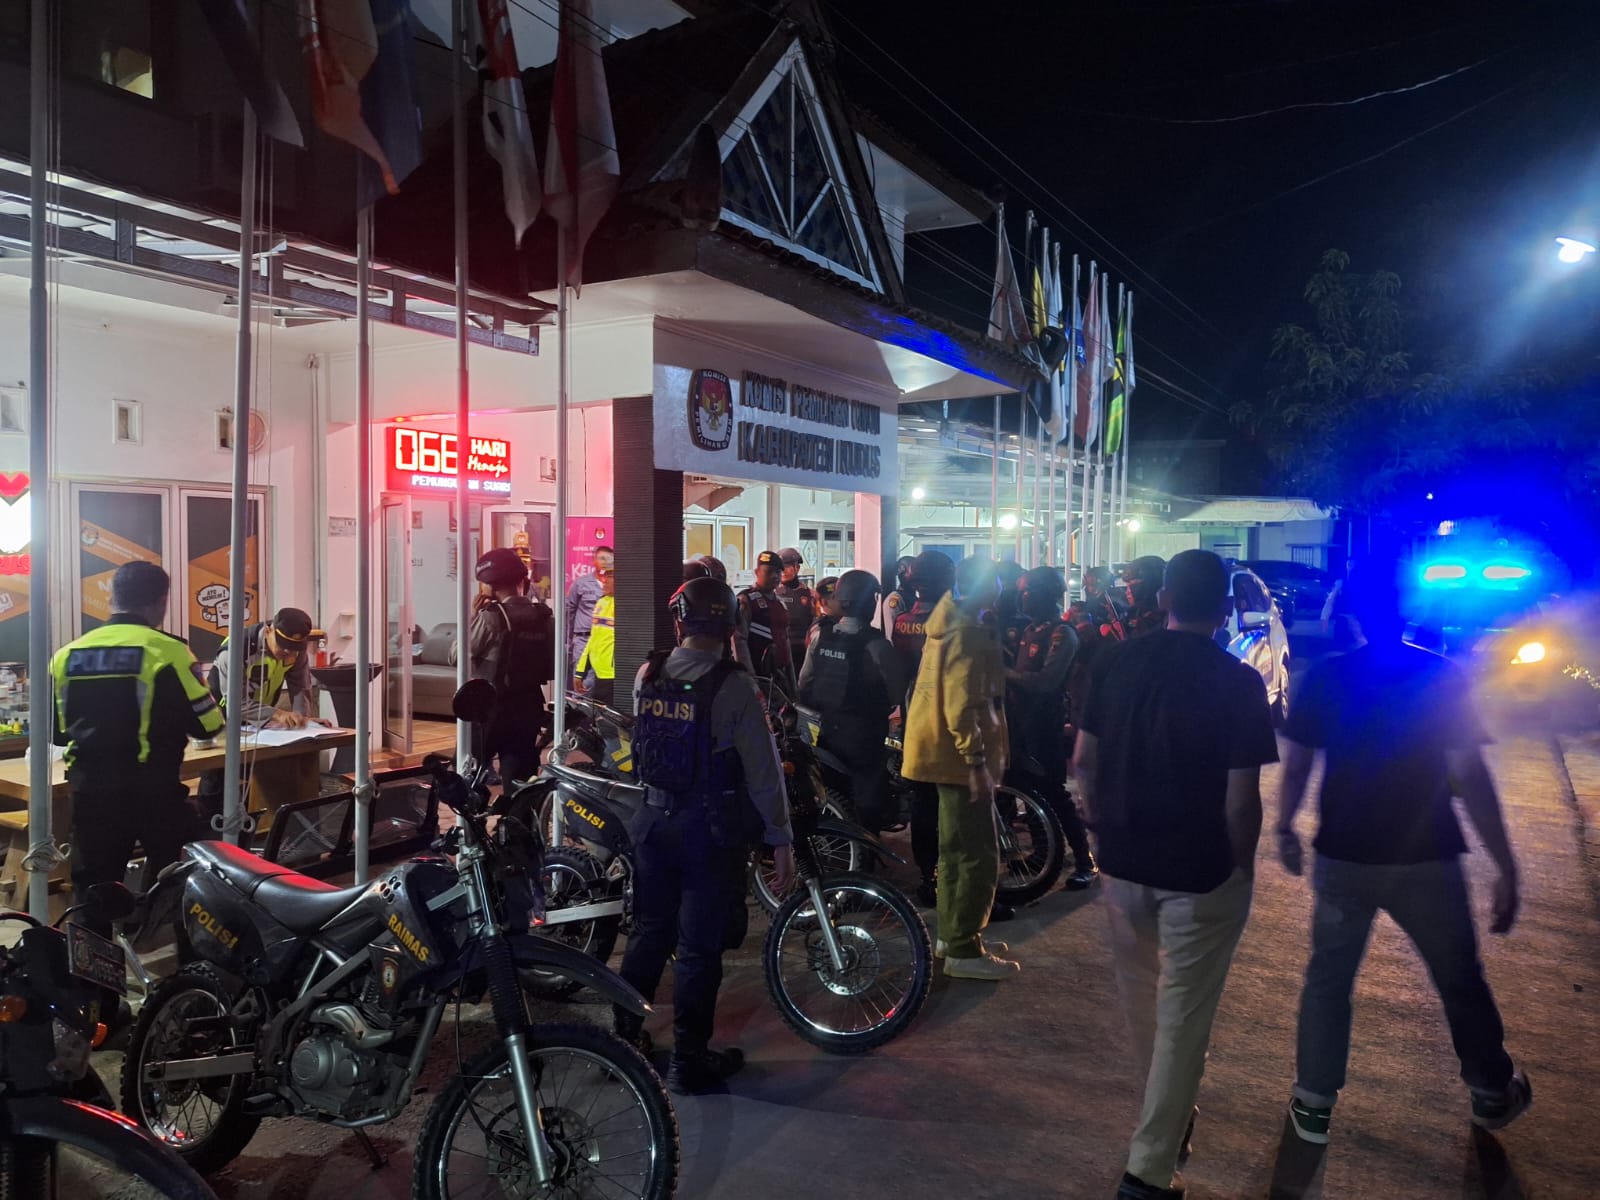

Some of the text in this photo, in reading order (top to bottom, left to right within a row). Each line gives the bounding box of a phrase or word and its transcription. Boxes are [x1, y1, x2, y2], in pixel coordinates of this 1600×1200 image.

[739, 370, 787, 414] KOMISI
[789, 384, 849, 428] PEMILIHAN
[471, 439, 506, 457] HARI
[738, 421, 881, 478] KABUPATEN KUDUS
[819, 648, 846, 660] POLISI
[640, 698, 695, 721] POLISI
[566, 799, 606, 829] POLISI
[190, 903, 238, 948] POLISI
[388, 913, 430, 961] RAIMAS
